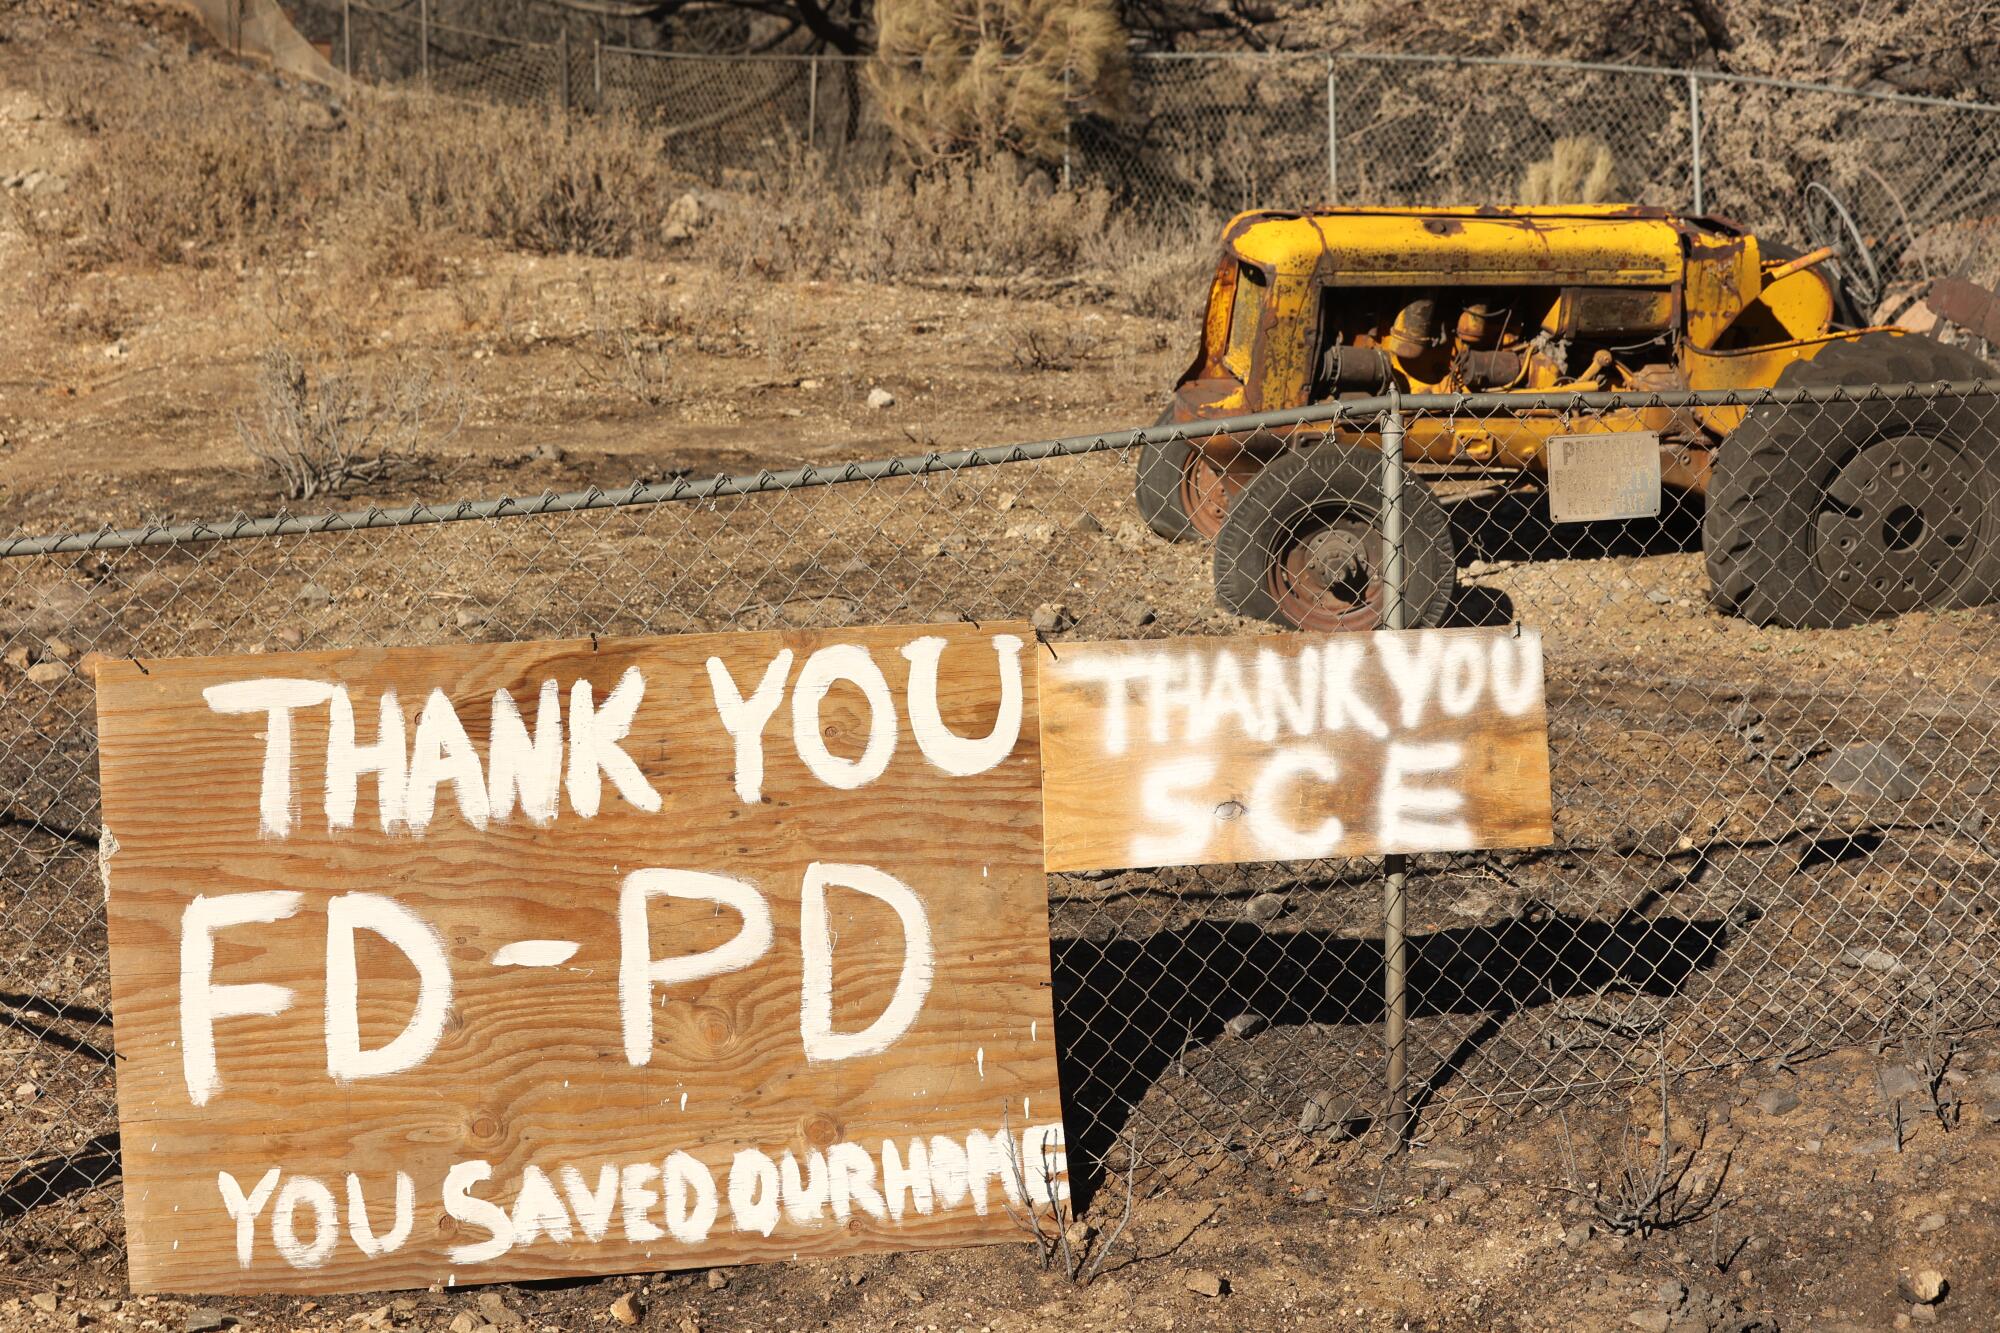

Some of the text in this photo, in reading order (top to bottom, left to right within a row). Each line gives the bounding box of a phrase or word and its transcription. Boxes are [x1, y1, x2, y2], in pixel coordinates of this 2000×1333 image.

[202, 635, 1023, 838] THANK YOU
[1058, 627, 1542, 756] THANK YOU
[1127, 741, 1474, 866] SCE
[217, 1121, 1071, 1269] YOU SAVED OUR HOME
